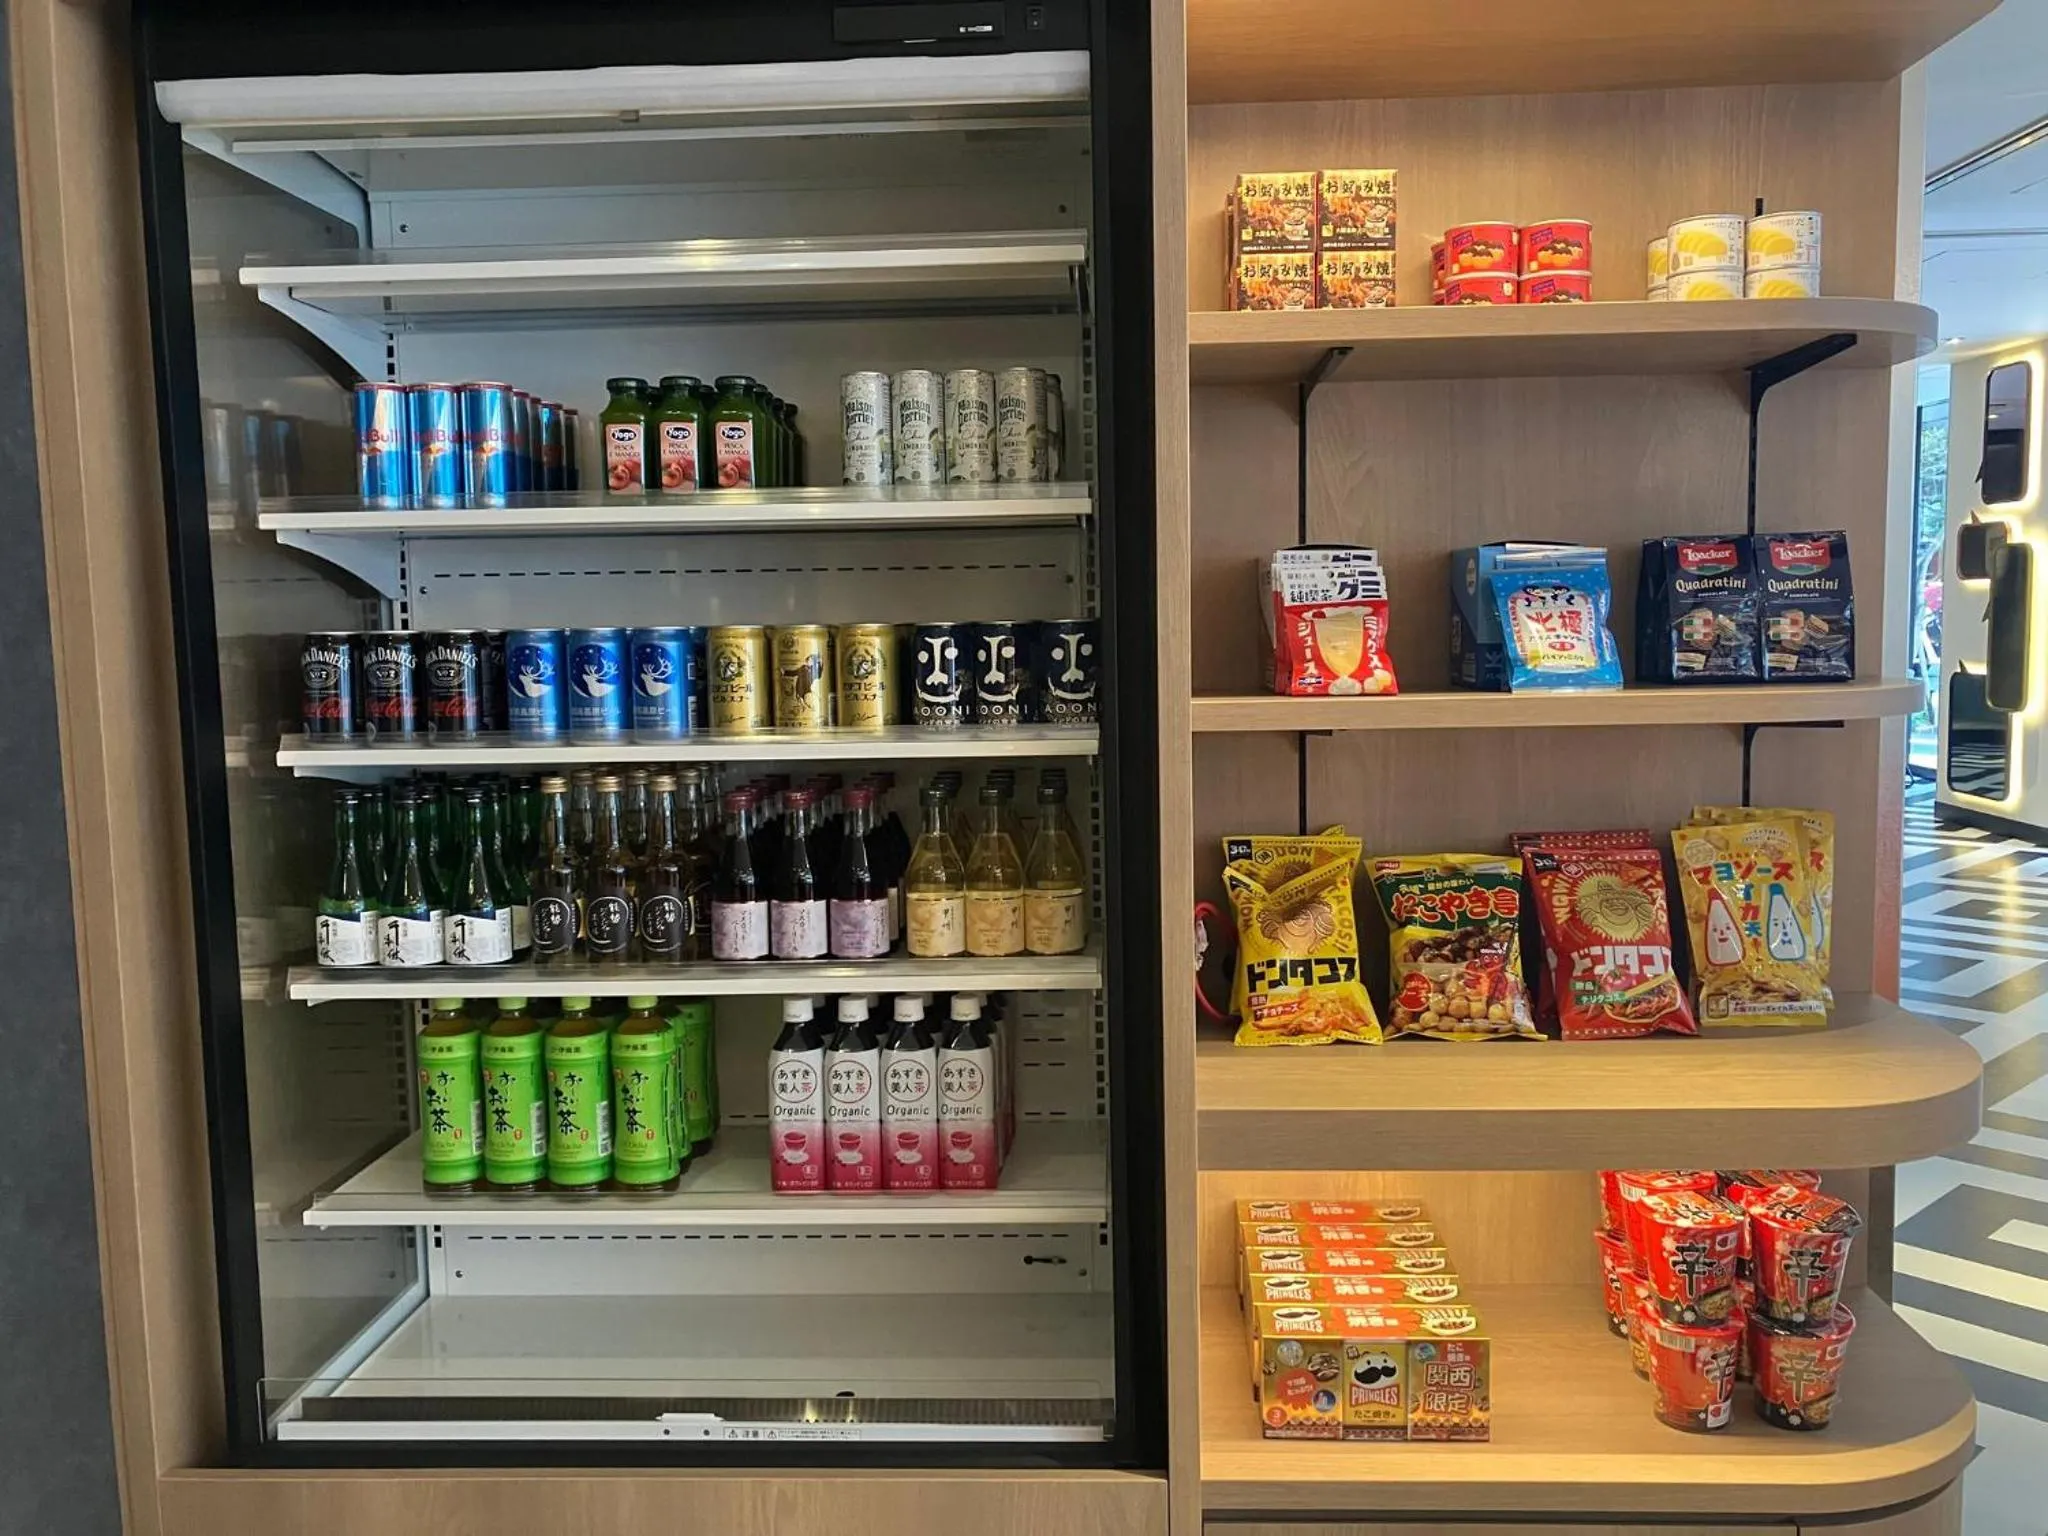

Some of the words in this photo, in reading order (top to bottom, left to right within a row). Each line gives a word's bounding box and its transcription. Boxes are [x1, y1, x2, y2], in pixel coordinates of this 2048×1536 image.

[1676, 577, 1746, 593] Quadratini
[1768, 578, 1839, 592] Quadratini
[378, 646, 418, 669] DANIEL'S
[438, 645, 479, 669] DANIEL'S
[1688, 860, 1795, 885] マヨソース
[778, 1069, 811, 1079] あずき
[832, 1069, 866, 1079] あずき
[891, 1068, 924, 1079] あずき
[944, 1067, 977, 1079] あずき
[778, 1082, 813, 1094] 美人茶
[832, 1082, 867, 1094] 美人茶
[891, 1081, 925, 1093] 美人茶
[944, 1080, 978, 1093] 美人茶
[774, 1105, 816, 1117] Organic
[828, 1105, 871, 1117] Organic
[887, 1104, 929, 1116] Organic
[940, 1103, 983, 1116] Organic
[1250, 1209, 1292, 1220] PRINGLES
[1257, 1233, 1301, 1245] PRINGLES
[1261, 1260, 1306, 1272] PRINGLES
[1670, 1242, 1718, 1299] 辛
[1782, 1247, 1831, 1307] 辛
[1265, 1288, 1312, 1301] PRINGLES
[1275, 1319, 1324, 1334] PRINGLES
[1427, 1364, 1472, 1387] 関西
[1778, 1350, 1828, 1404] 辛
[1351, 1384, 1399, 1406] PRINGLES
[1425, 1392, 1470, 1414] 限定
